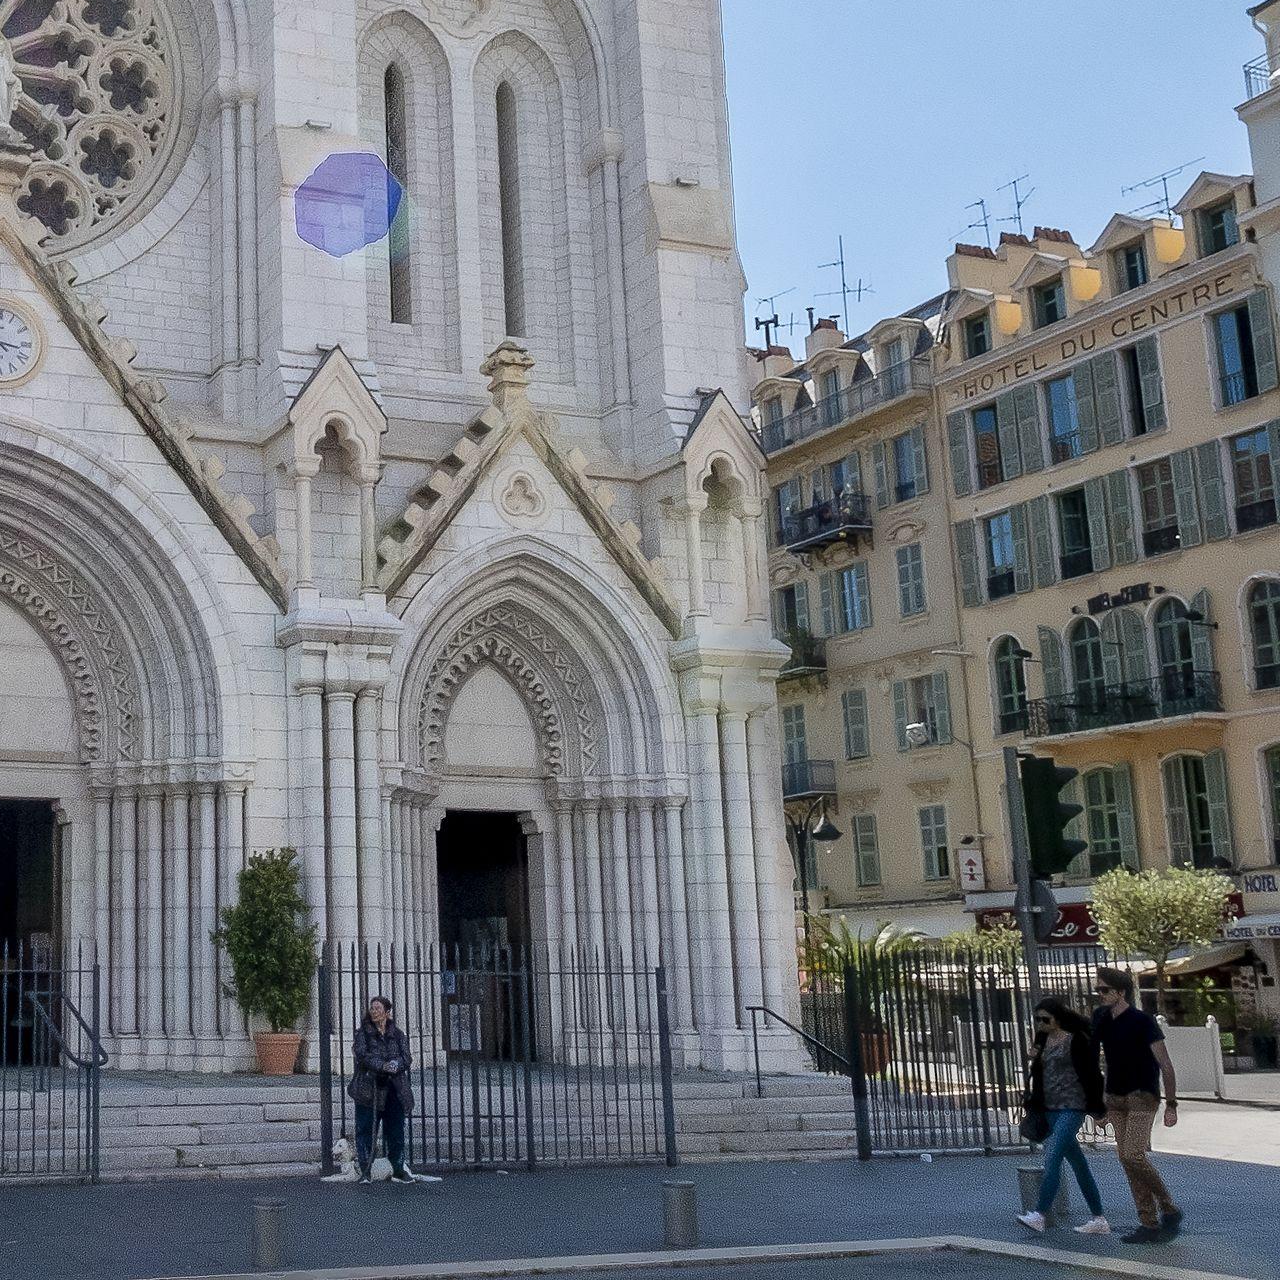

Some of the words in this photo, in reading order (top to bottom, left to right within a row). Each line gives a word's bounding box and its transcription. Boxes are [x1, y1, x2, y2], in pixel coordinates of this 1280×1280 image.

[964, 354, 1048, 399] HOTEL
[1061, 329, 1096, 360] DU
[1111, 272, 1234, 337] CENTRE
[1245, 874, 1278, 892] HOTEL
[1227, 927, 1254, 938] HOTEL
